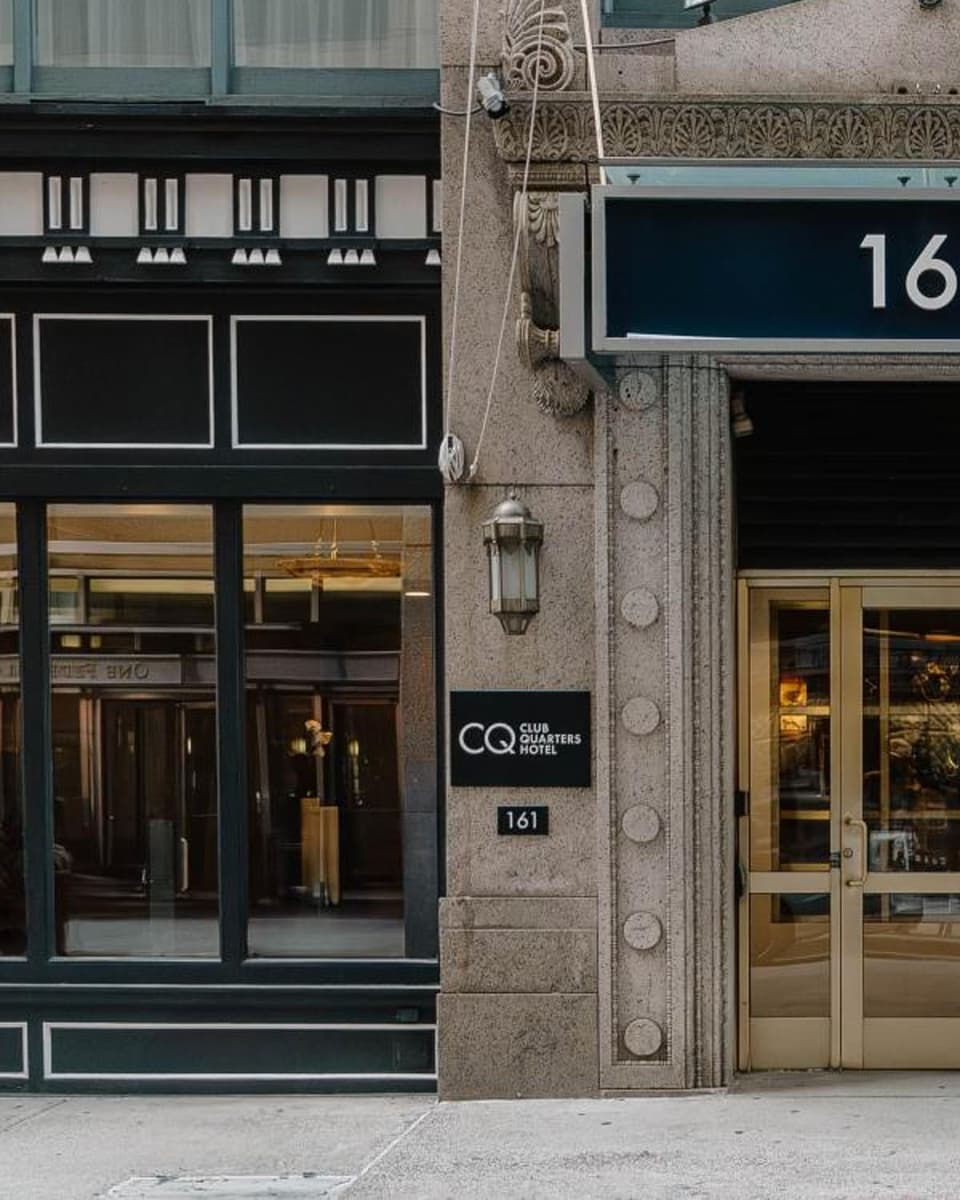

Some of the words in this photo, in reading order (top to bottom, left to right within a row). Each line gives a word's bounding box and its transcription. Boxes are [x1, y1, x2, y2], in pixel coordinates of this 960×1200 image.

[519, 722, 549, 733] CLUB
[458, 722, 515, 754] CQ
[519, 733, 581, 744] QUARTERS
[519, 744, 557, 755] HOTEL
[506, 810, 537, 829] 161
